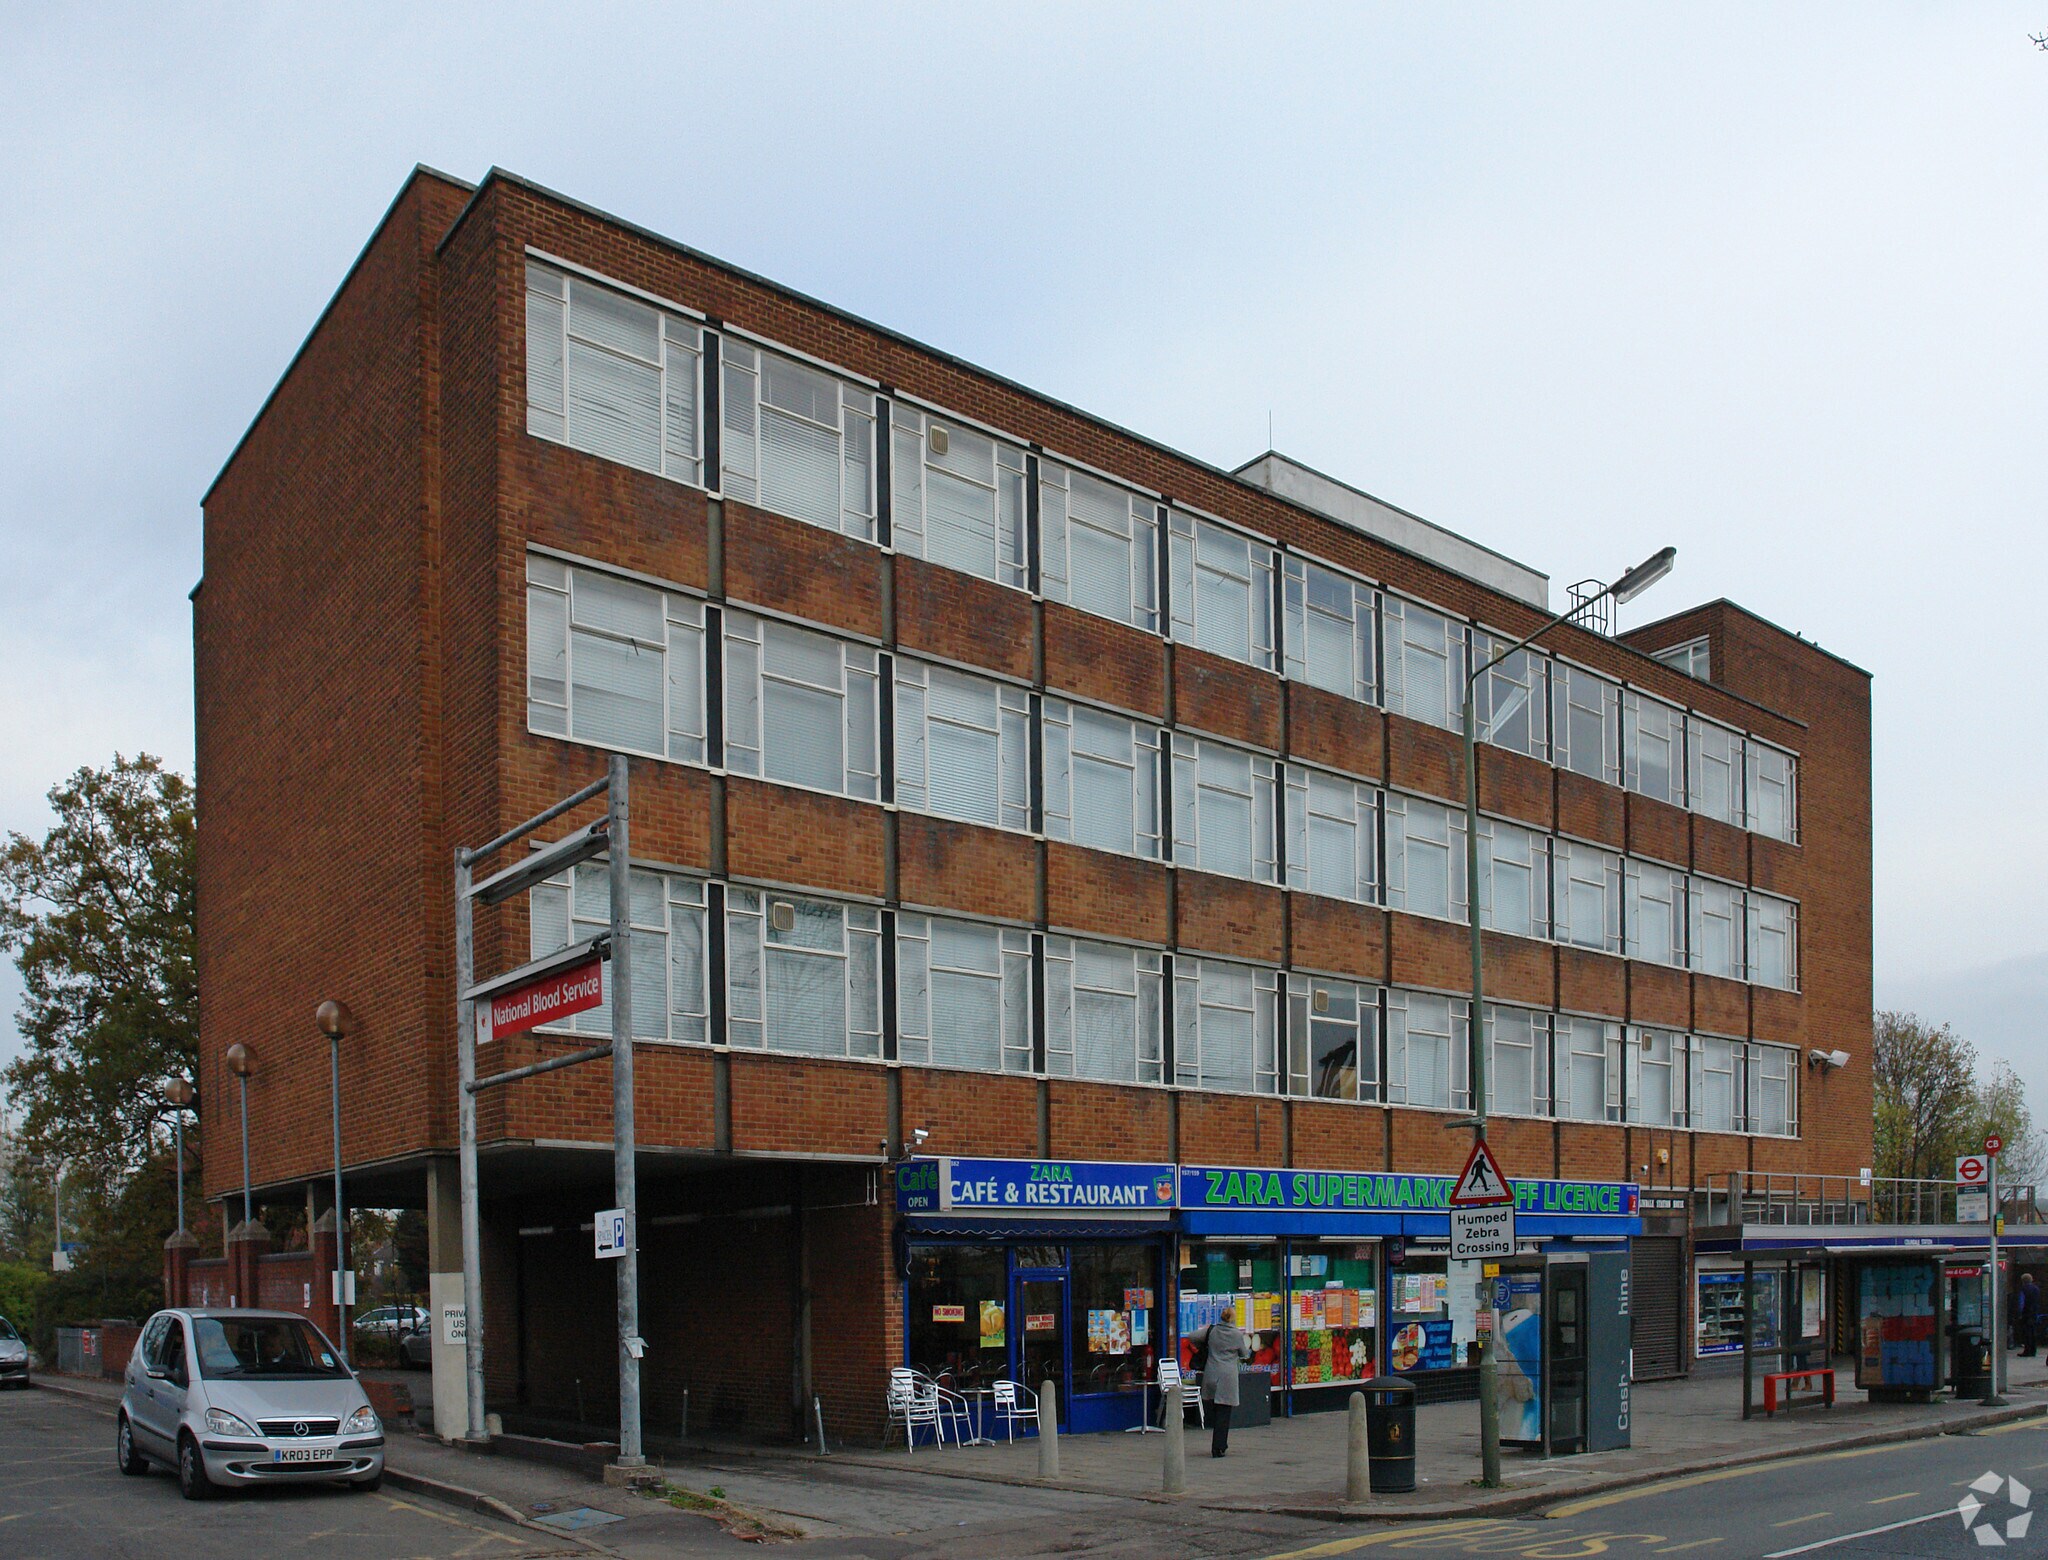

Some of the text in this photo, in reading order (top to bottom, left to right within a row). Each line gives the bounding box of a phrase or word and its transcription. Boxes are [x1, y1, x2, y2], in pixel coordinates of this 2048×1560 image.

[493, 975, 599, 1027] National Blood Service
[1986, 1140, 1999, 1149] CB
[898, 1164, 938, 1191] Café
[1030, 1164, 1073, 1182] ZARA
[950, 1176, 1149, 1206] CAFÉ & RESTAURANT
[1205, 1171, 1285, 1206] ZARA
[1292, 1174, 1467, 1209] SUPERMARKE
[1543, 1183, 1620, 1212] LICENCE
[908, 1196, 929, 1208] OPEN
[1457, 1211, 1508, 1225] Humped
[1465, 1227, 1500, 1239] Zebra
[1457, 1240, 1510, 1254] Crossing
[453, 1320, 465, 1328] US
[1618, 1373, 1629, 1431] Cash
[281, 1449, 333, 1461] KR03 EPP
